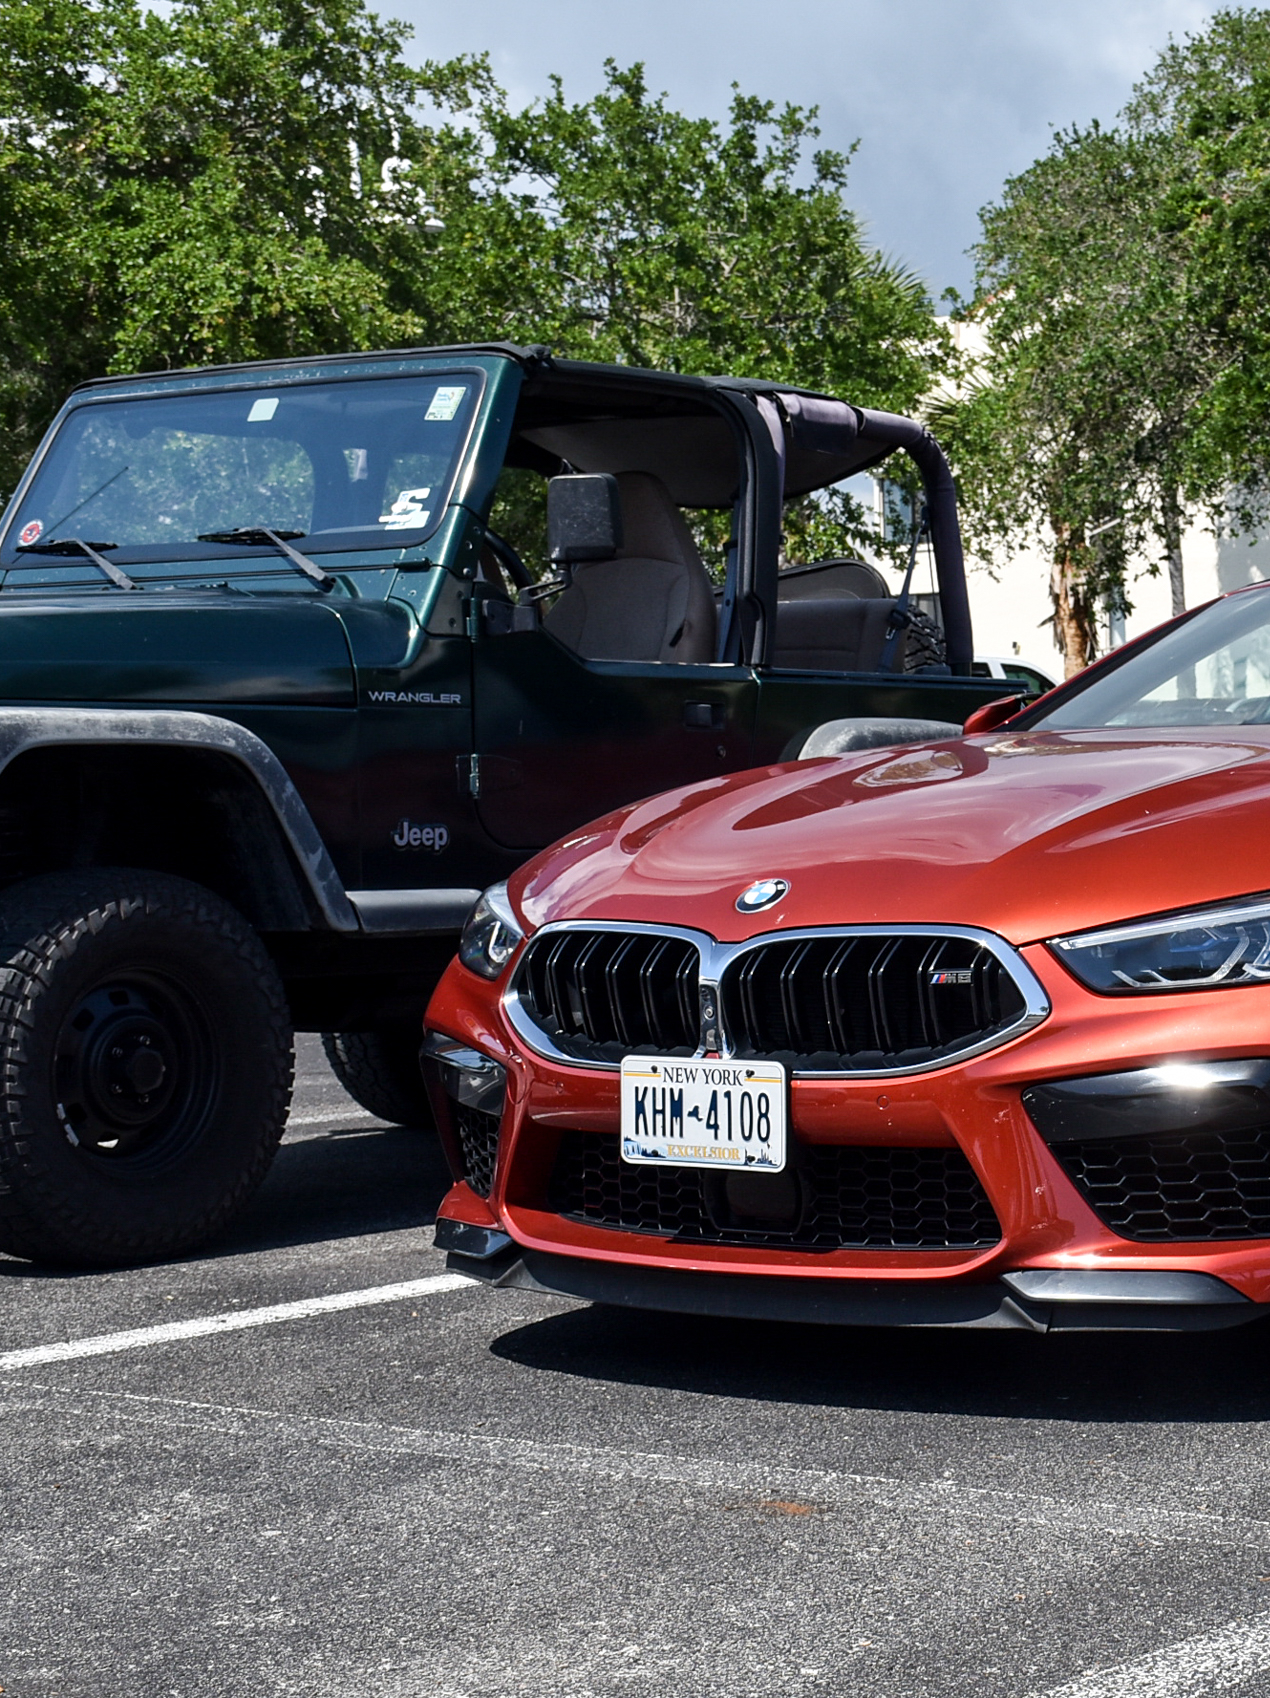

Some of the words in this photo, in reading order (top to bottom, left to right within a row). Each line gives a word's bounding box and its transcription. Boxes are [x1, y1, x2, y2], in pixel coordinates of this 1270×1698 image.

[368, 690, 461, 704] WRANGLER
[393, 821, 448, 850] Jeep
[663, 1067, 702, 1084] NEW
[702, 1068, 743, 1086] YORK
[667, 1144, 741, 1161] EXCELSIOR
